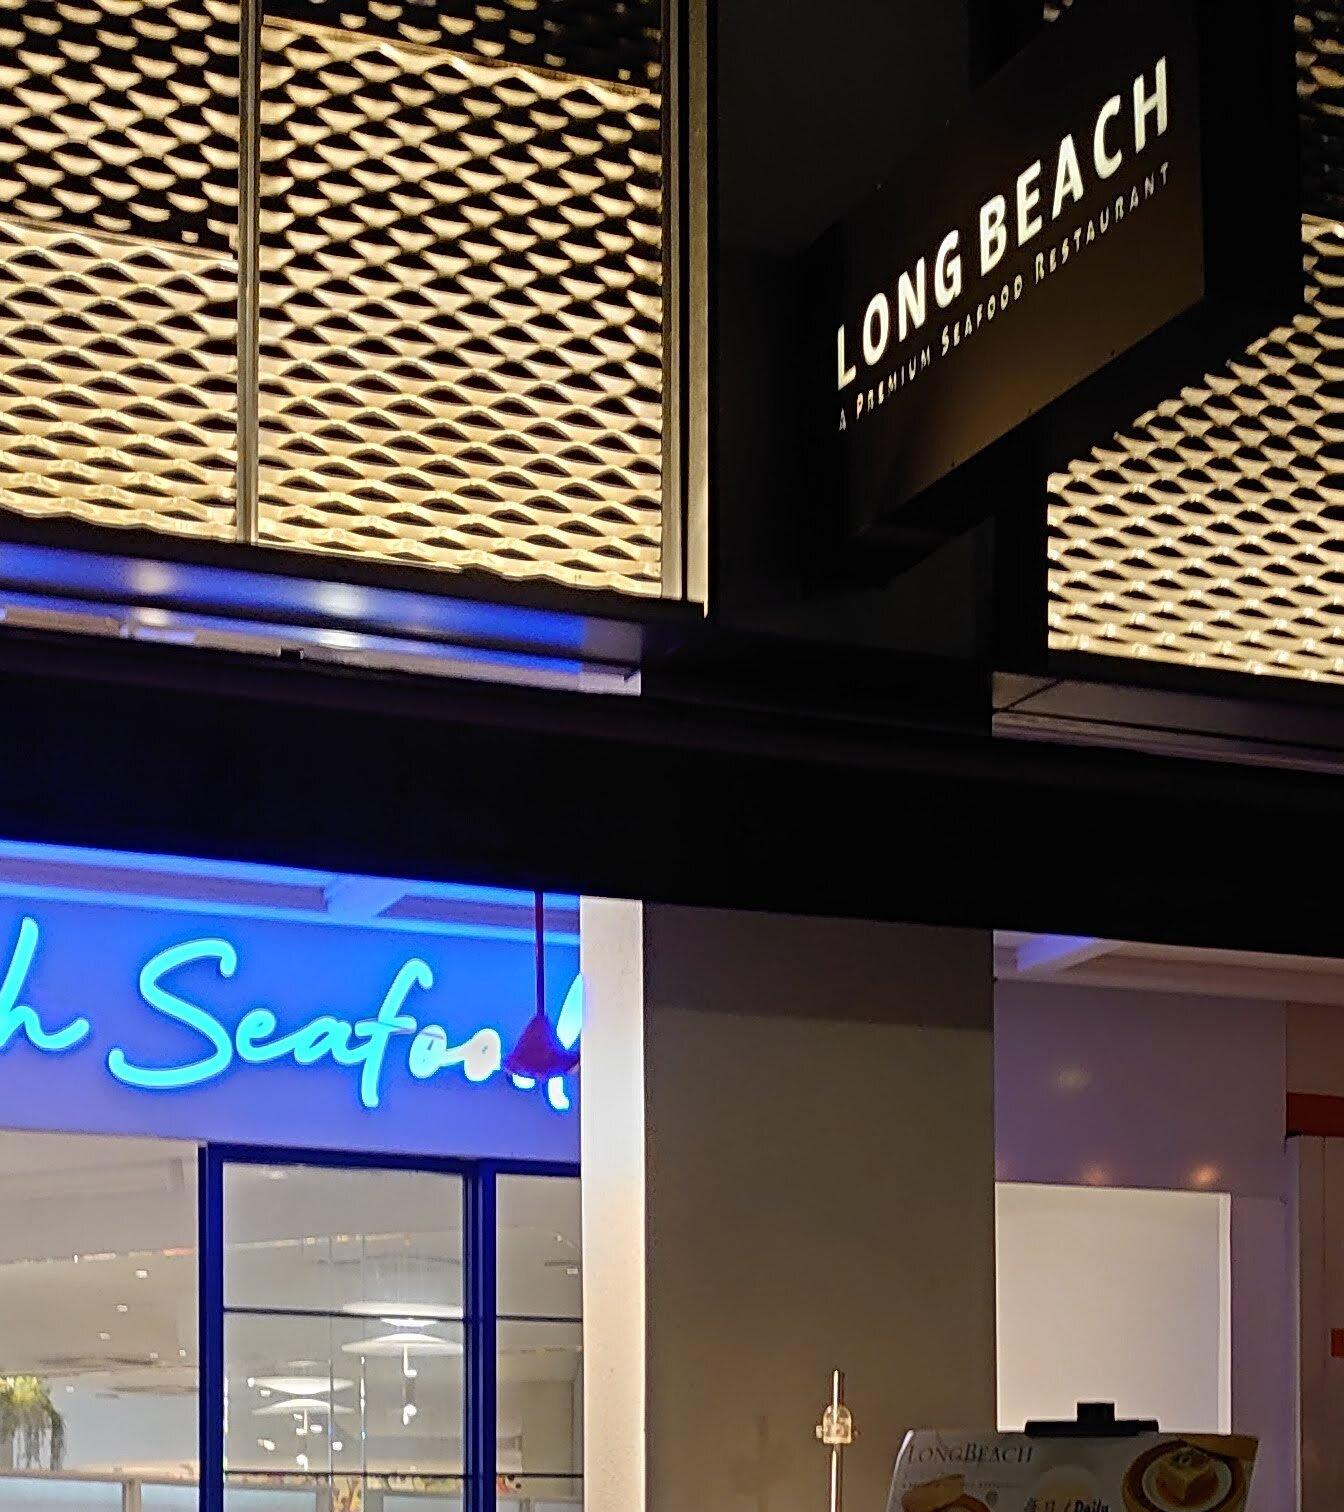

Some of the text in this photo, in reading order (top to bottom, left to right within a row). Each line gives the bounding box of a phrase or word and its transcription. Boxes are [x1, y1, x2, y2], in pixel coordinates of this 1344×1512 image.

[836, 55, 1170, 391] LONG BEACH
[838, 161, 1170, 431] A PREMIUM SEAFOOD RESTAURANT
